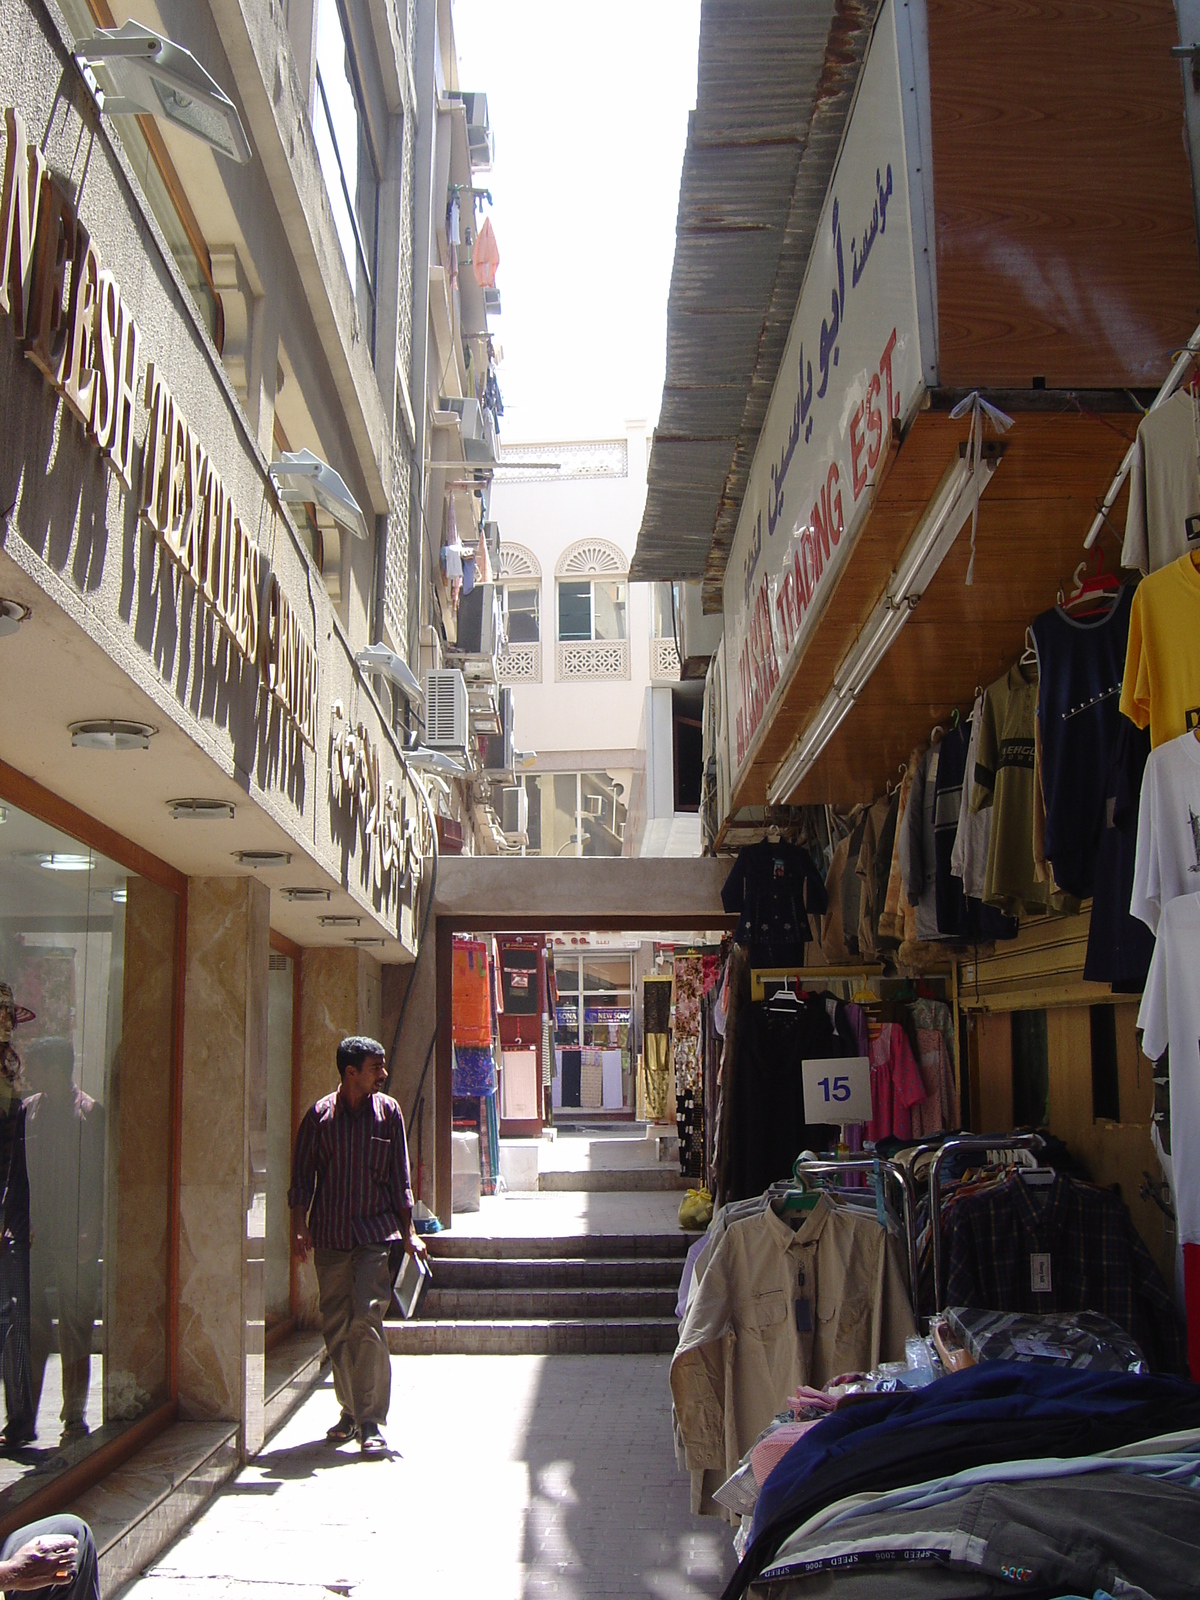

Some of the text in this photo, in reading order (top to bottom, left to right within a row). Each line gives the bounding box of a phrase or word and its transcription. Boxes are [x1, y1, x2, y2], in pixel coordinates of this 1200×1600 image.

[853, 164, 892, 288] مؤسسة
[139, 363, 260, 664] TEXTILES
[260, 571, 320, 753] CENTER
[777, 461, 843, 654] TRADING
[818, 1076, 851, 1102] 15
[830, 1554, 859, 1566] SPEED
[875, 1551, 896, 1561] 2006
[904, 1550, 930, 1560] SPEED
[805, 1560, 823, 1571] 2006
